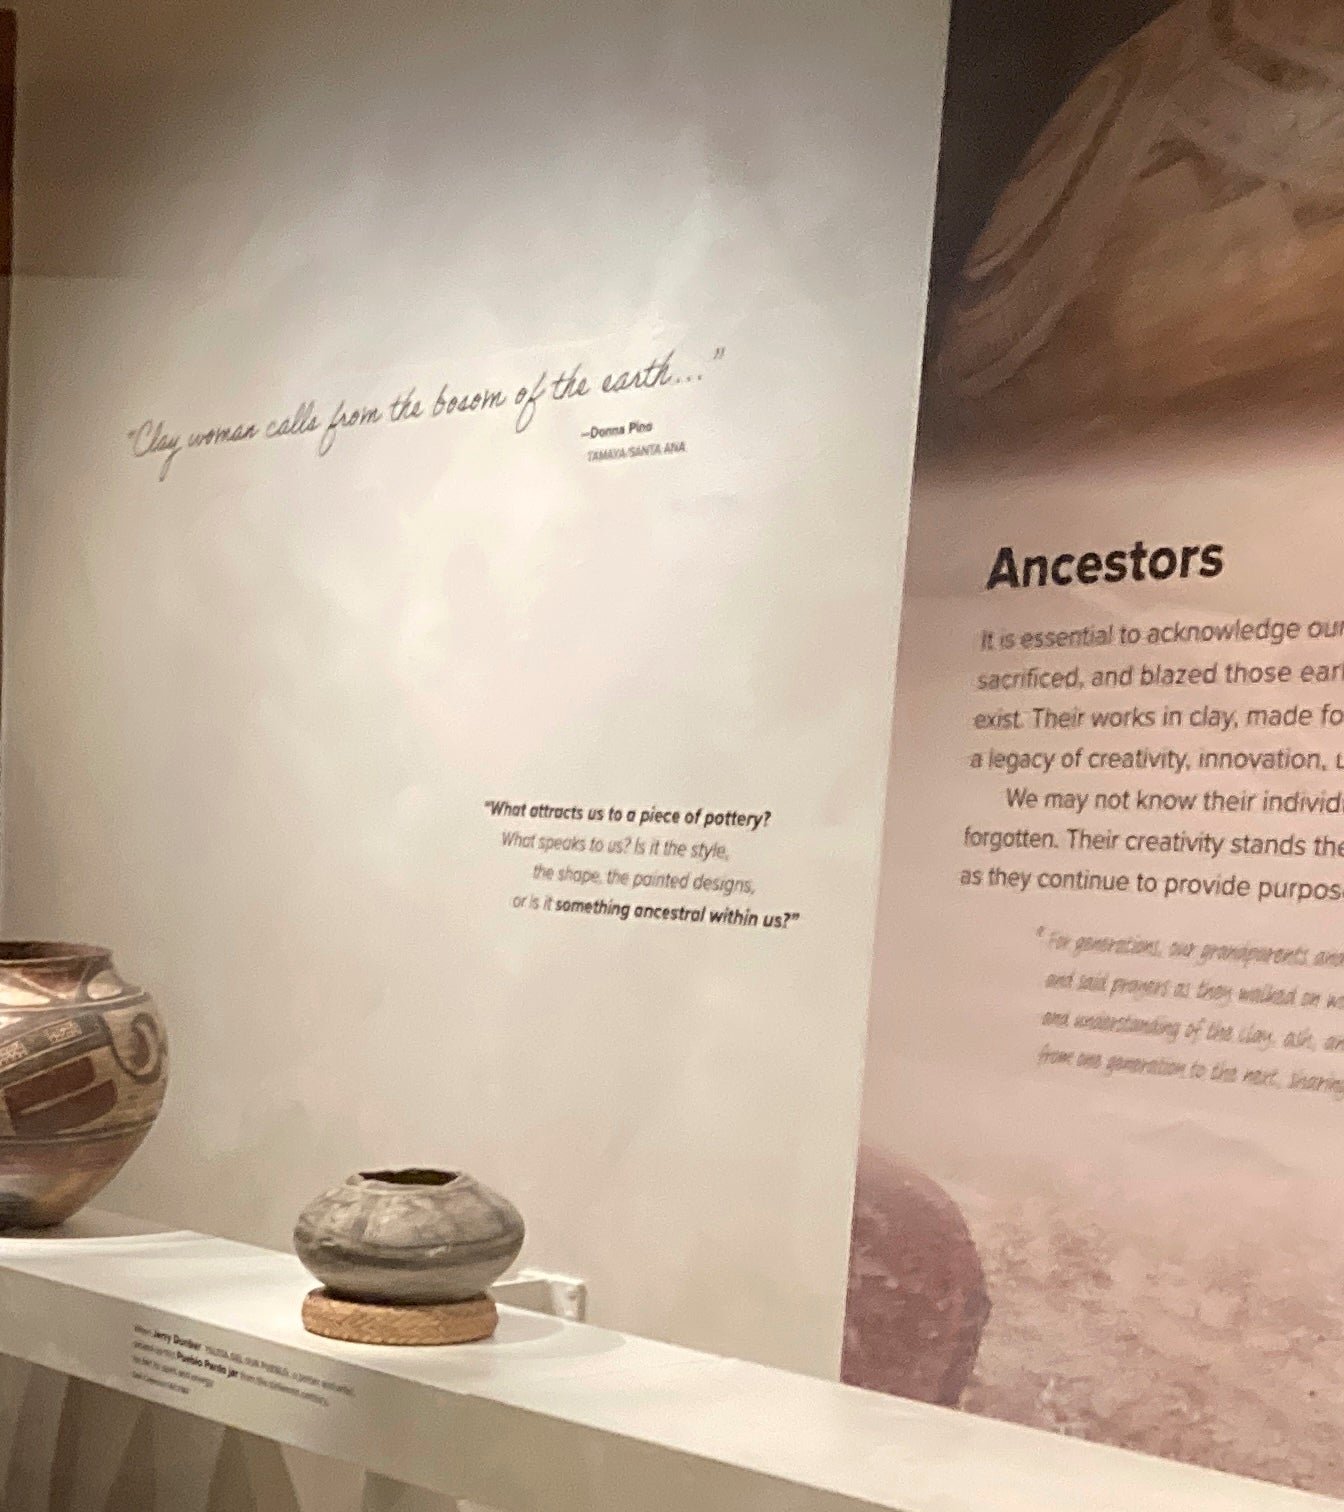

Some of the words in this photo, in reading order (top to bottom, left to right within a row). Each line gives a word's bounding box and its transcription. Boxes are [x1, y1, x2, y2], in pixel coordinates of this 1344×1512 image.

[188, 422, 258, 448] woman
[265, 400, 320, 439] calls
[318, 400, 383, 457] from
[390, 386, 425, 421] the
[431, 384, 508, 418] bosom
[514, 371, 546, 433] of
[552, 363, 590, 400] the
[985, 541, 1224, 590] Ancestors
[981, 629, 994, 650] It
[1000, 630, 1015, 649] is
[1020, 625, 1113, 649] essential
[1120, 623, 1141, 644] to
[1147, 617, 1300, 645] acknowledge
[977, 665, 1084, 690] sacrificed,
[1092, 664, 1133, 686] and
[1140, 662, 1218, 685] blazed
[1225, 662, 1292, 683] those
[1033, 706, 1085, 729] Their
[1091, 706, 1155, 728] works
[1163, 706, 1182, 726] in
[1190, 705, 1239, 732] clay,
[1247, 706, 1313, 726] made
[970, 753, 982, 768] a
[989, 747, 1056, 774] legacy
[1062, 747, 1083, 768] of
[1088, 748, 1191, 774] creativity,
[1199, 748, 1327, 771] innovation,
[1006, 787, 1038, 808] We
[1044, 792, 1089, 814] may
[1095, 790, 1130, 809] not
[1136, 789, 1196, 810] know
[1204, 789, 1257, 811] their
[529, 805, 583, 820] attracts
[588, 808, 604, 821] us
[608, 806, 623, 821] to
[626, 811, 636, 822] a
[639, 805, 680, 826] piece
[684, 807, 703, 824] of
[703, 809, 772, 831] pottery?
[502, 831, 535, 848] What
[538, 833, 585, 853] speaks
[590, 835, 604, 850] to
[608, 836, 630, 853] us?
[634, 836, 646, 853] Is
[650, 837, 660, 854] it
[664, 839, 685, 856] the
[690, 840, 729, 861] style,
[964, 825, 1059, 852] forgotten.
[1067, 828, 1120, 849] Their
[1125, 831, 1225, 859] creativity
[1230, 833, 1306, 856] stands
[533, 864, 554, 881] the
[606, 868, 629, 884] the
[632, 869, 689, 890] painted
[692, 873, 757, 895] designs,
[961, 870, 982, 885] as
[988, 867, 1032, 892] they
[1037, 869, 1130, 892] continue
[1137, 873, 1157, 893] to
[1164, 873, 1251, 898] provide
[512, 896, 526, 909] or
[529, 895, 540, 910] is
[543, 896, 554, 911] it
[555, 898, 630, 920] something
[634, 902, 705, 923] ancestral
[709, 906, 759, 927] within
